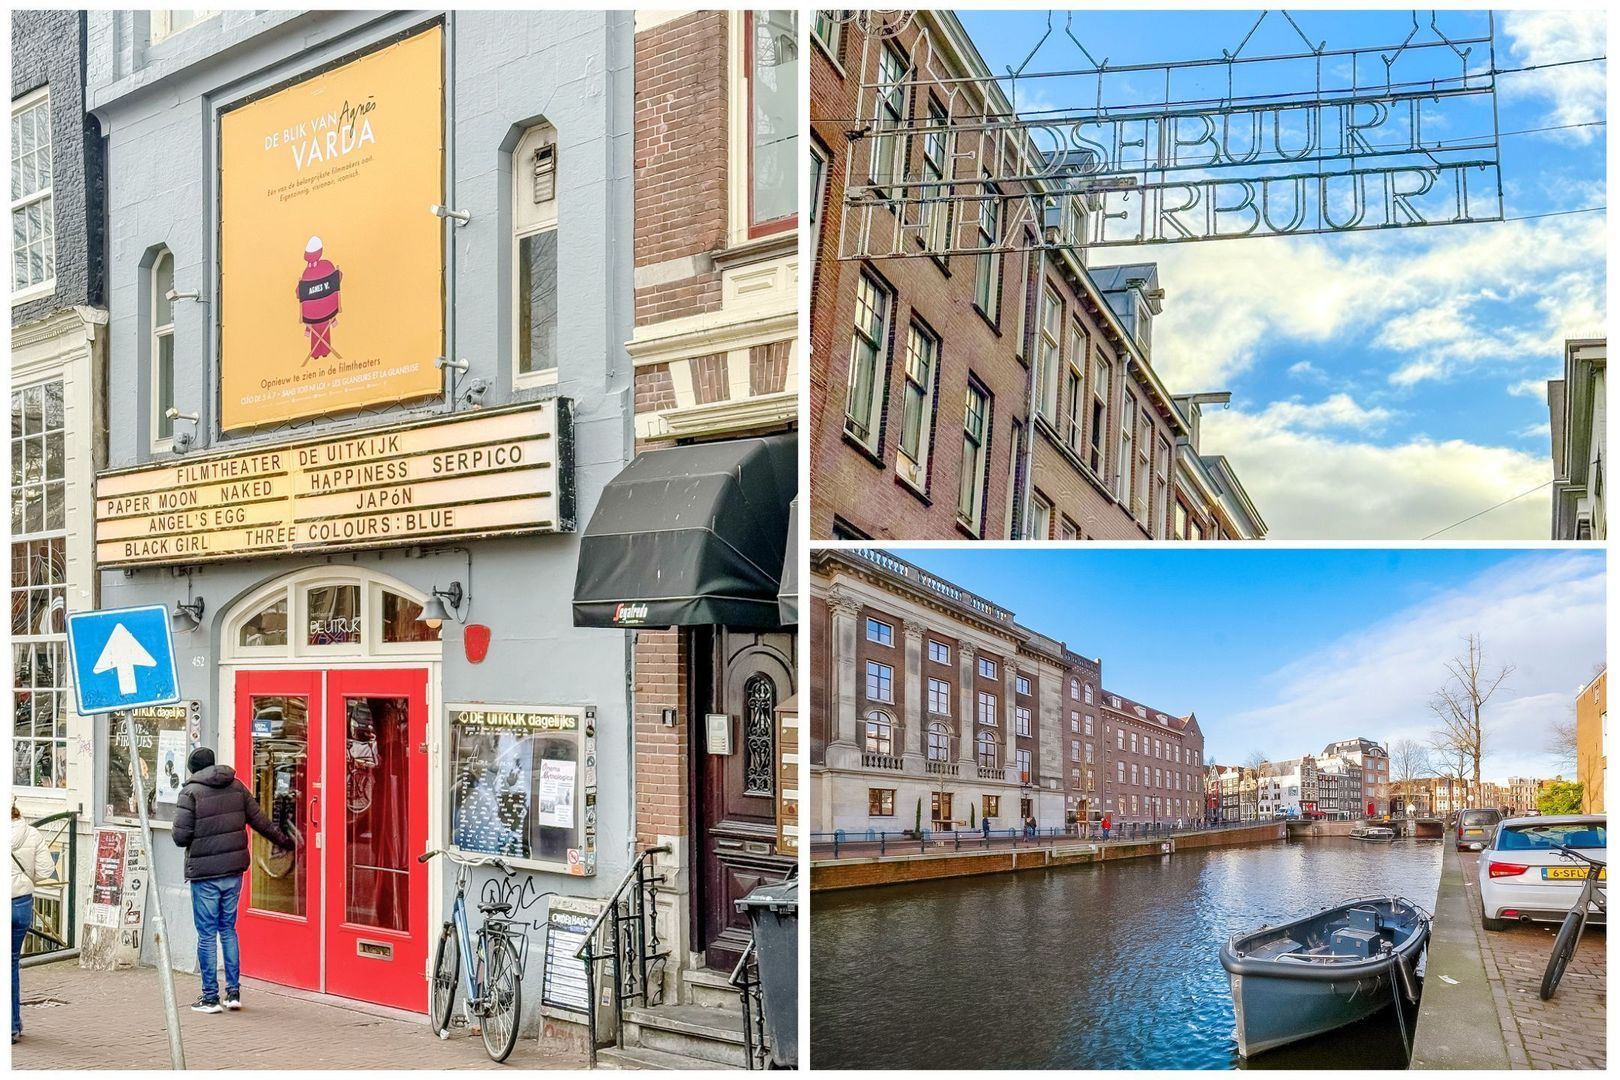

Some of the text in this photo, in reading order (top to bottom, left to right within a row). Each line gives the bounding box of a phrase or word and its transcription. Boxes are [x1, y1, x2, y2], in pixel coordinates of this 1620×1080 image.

[264, 135, 279, 151] DE
[283, 122, 307, 144] BLIK
[311, 111, 338, 133] VAN
[291, 117, 376, 171] VARDA
[260, 358, 381, 390] Opnieuw te zien in de filmtheaters
[177, 435, 400, 484] FILMTHEATER DE UITKIJK
[108, 445, 523, 515] PAPER MOON NAKED HAPPINESS SERPICO
[149, 511, 208, 532] ANGEL'S
[215, 507, 246, 526] EGG
[125, 538, 169, 557] BLACK
[175, 535, 209, 552] GIRL
[245, 526, 296, 547] THREE
[192, 655, 205, 667] 452
[157, 707, 186, 719] dagelijks
[469, 712, 575, 730] DE UITKIJK dagelijks
